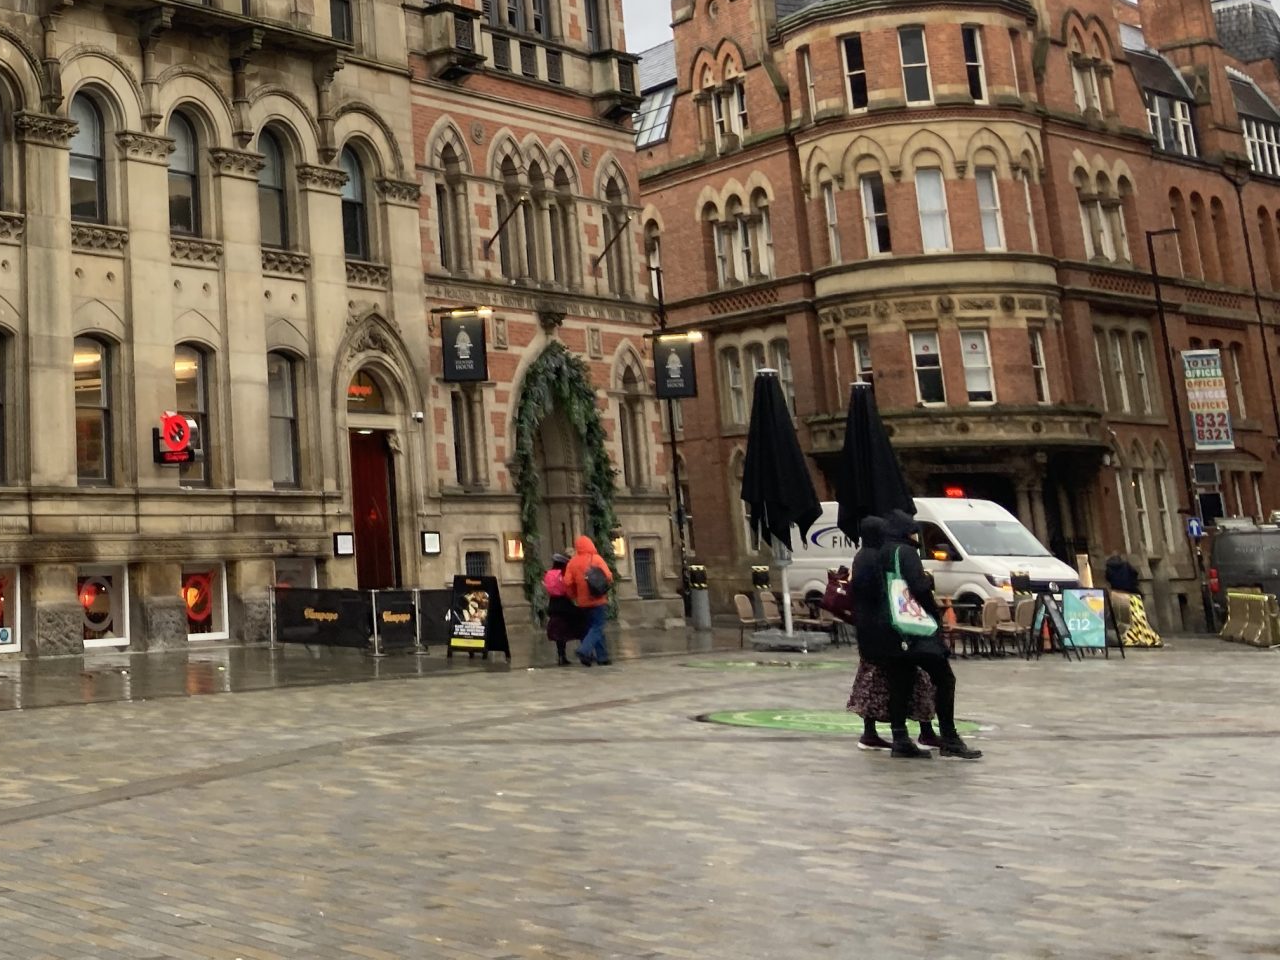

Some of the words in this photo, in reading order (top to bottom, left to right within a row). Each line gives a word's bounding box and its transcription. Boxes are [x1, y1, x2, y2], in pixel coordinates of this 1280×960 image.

[1201, 360, 1217, 368] LET
[1186, 369, 1222, 378] OFFICES
[1187, 380, 1224, 388] OFFICES
[1190, 401, 1228, 410] OFFICES
[1195, 413, 1228, 428] 832
[1197, 429, 1230, 441] 8321
[1068, 618, 1091, 631] £12
